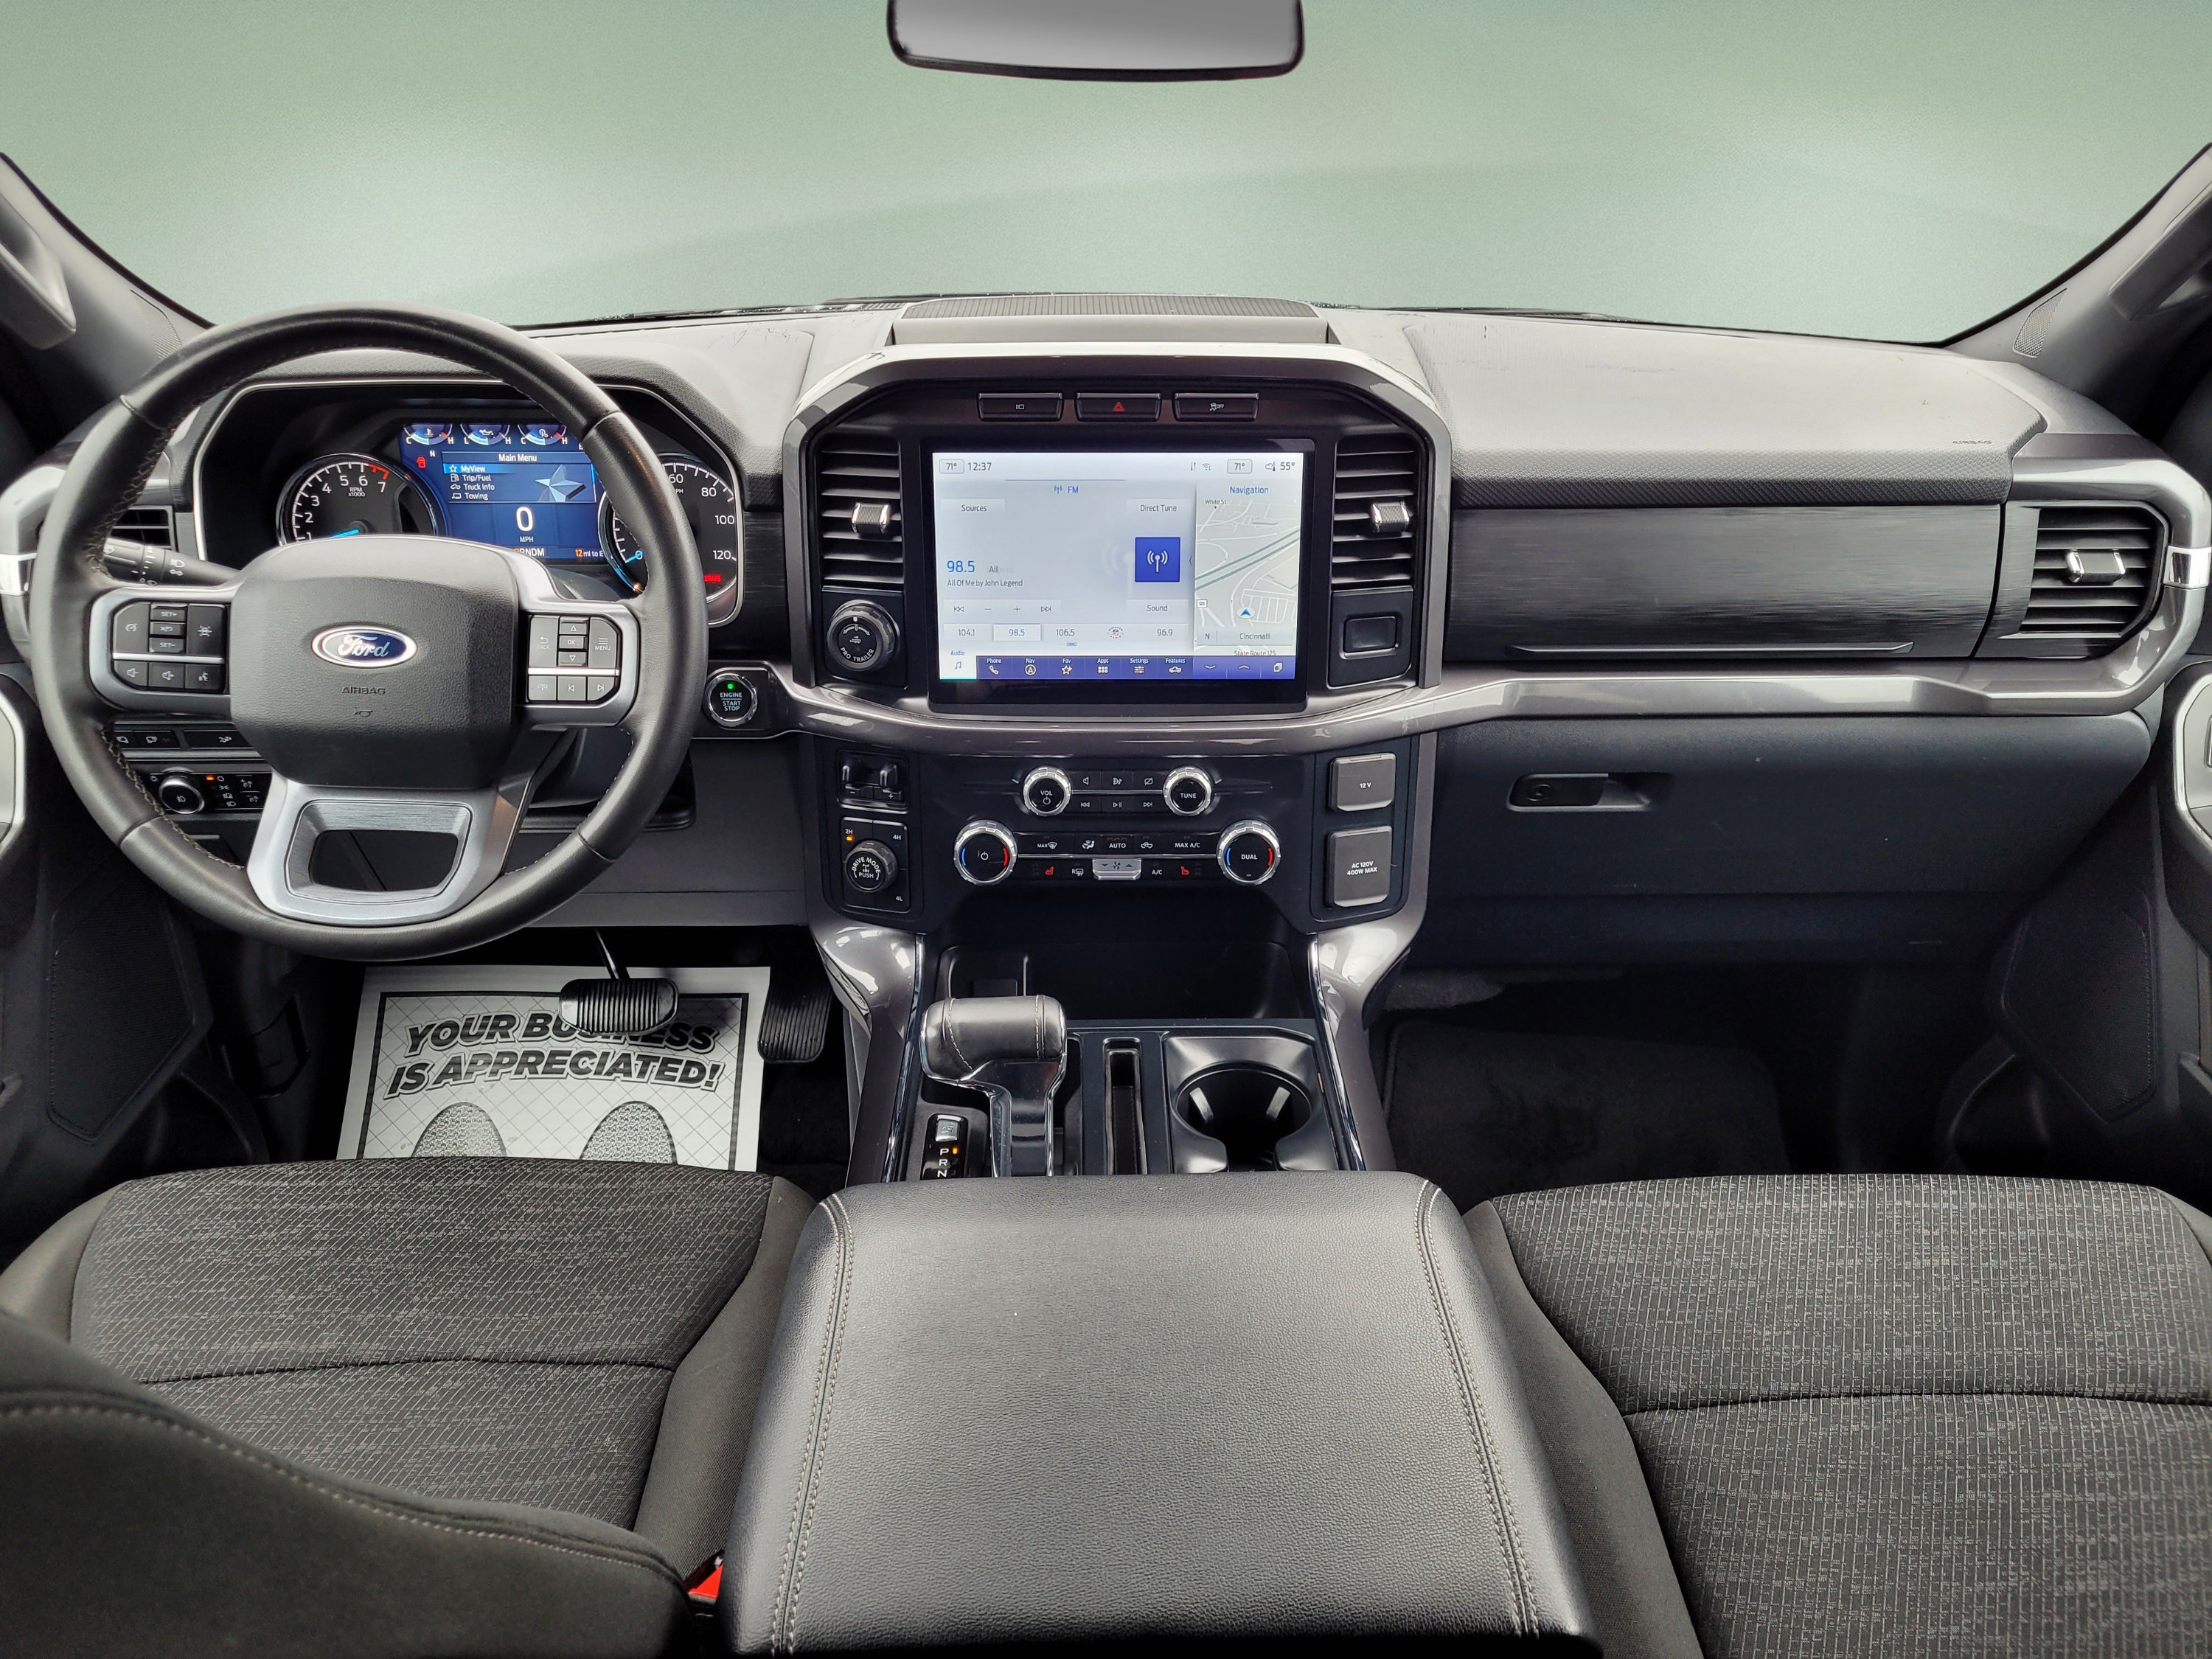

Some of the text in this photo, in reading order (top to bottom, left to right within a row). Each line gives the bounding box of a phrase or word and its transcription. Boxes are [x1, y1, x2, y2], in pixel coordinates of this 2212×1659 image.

[967, 462, 992, 471] 12:37
[1280, 462, 1295, 470] 55°
[340, 476, 349, 486] 5
[358, 476, 368, 486] 6
[668, 474, 684, 483] 60
[322, 483, 331, 493] 4
[378, 482, 386, 493] 7
[701, 488, 717, 497] 80
[1230, 487, 1269, 495] Navigation
[311, 496, 320, 507] 3
[305, 512, 314, 523] 2
[516, 507, 533, 532] 0
[715, 515, 735, 525] 100
[306, 532, 312, 540] 1
[575, 549, 583, 557] 12
[713, 550, 731, 560] 120
[947, 560, 975, 573] 98.5
[976, 580, 983, 588] by
[1000, 580, 1023, 588] Legend
[338, 634, 390, 657] Ford
[841, 647, 874, 662] PRO TRAILER
[341, 686, 386, 695] AIRBAG
[852, 857, 881, 873] DRIVE MODE
[405, 1012, 518, 1056] YOUR
[386, 1050, 724, 1097] IS APPRECIATED!
